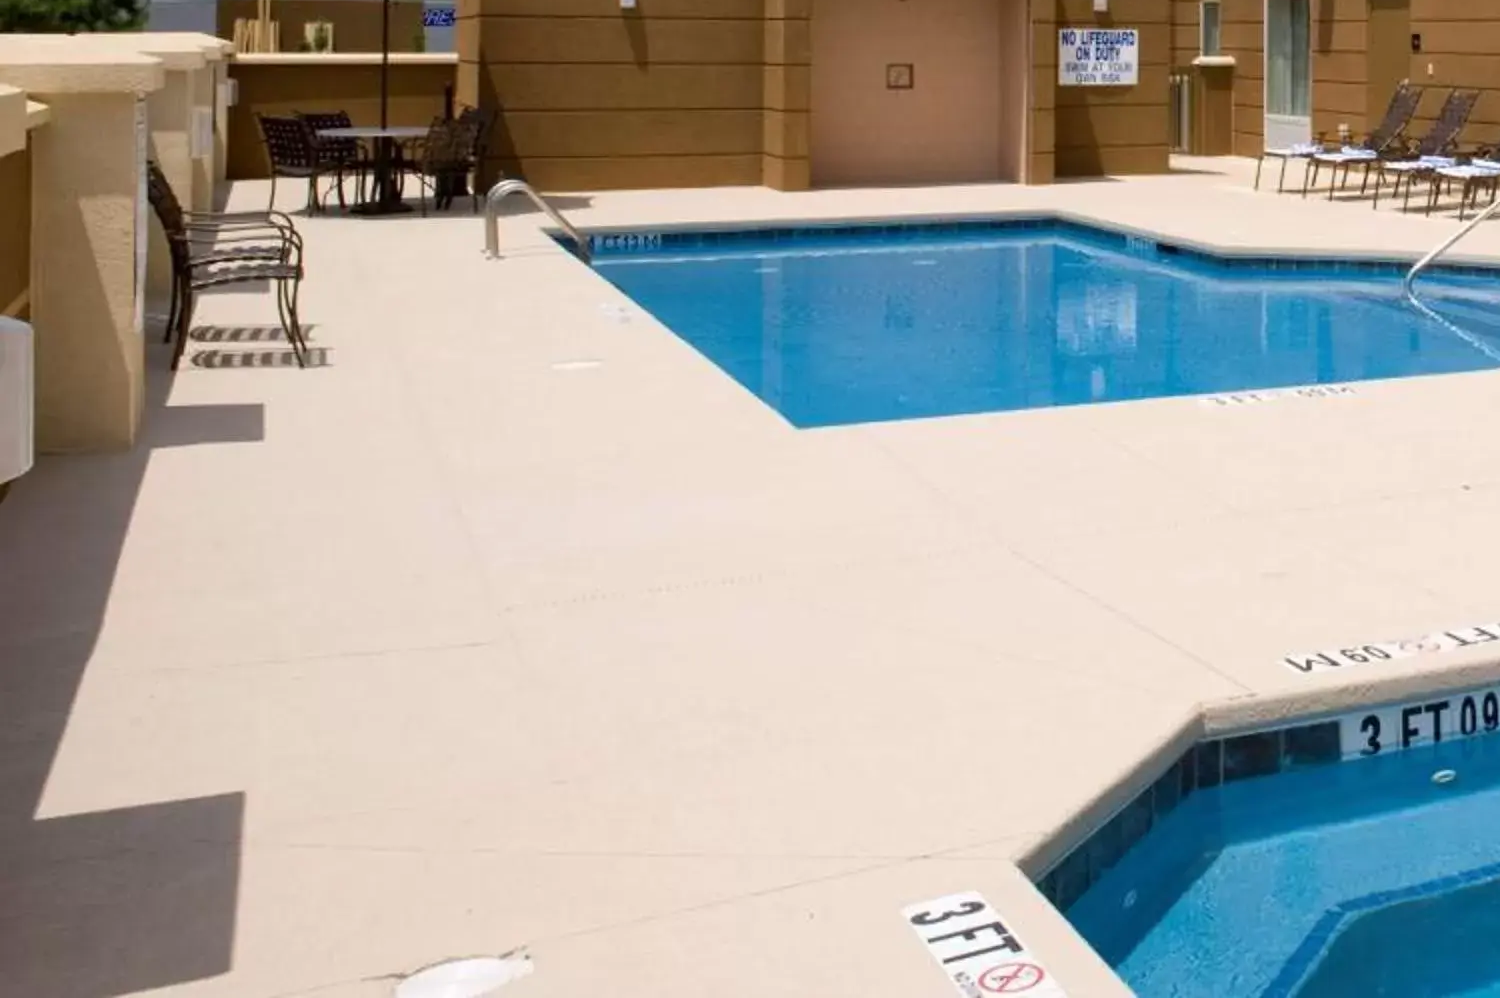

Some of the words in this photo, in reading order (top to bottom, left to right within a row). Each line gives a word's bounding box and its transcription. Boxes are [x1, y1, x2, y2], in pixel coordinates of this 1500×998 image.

[1062, 31, 1077, 46] NO
[1081, 31, 1135, 46] LIFEGUARD
[1075, 47, 1091, 60] ON
[1095, 47, 1121, 60] DUTY
[1444, 626, 1499, 647] FT
[1284, 652, 1341, 674] M
[1360, 714, 1381, 757] 3
[1401, 700, 1450, 749] FT
[1459, 691, 1499, 735] 09
[910, 901, 986, 926] 3
[927, 921, 1024, 965] FT
